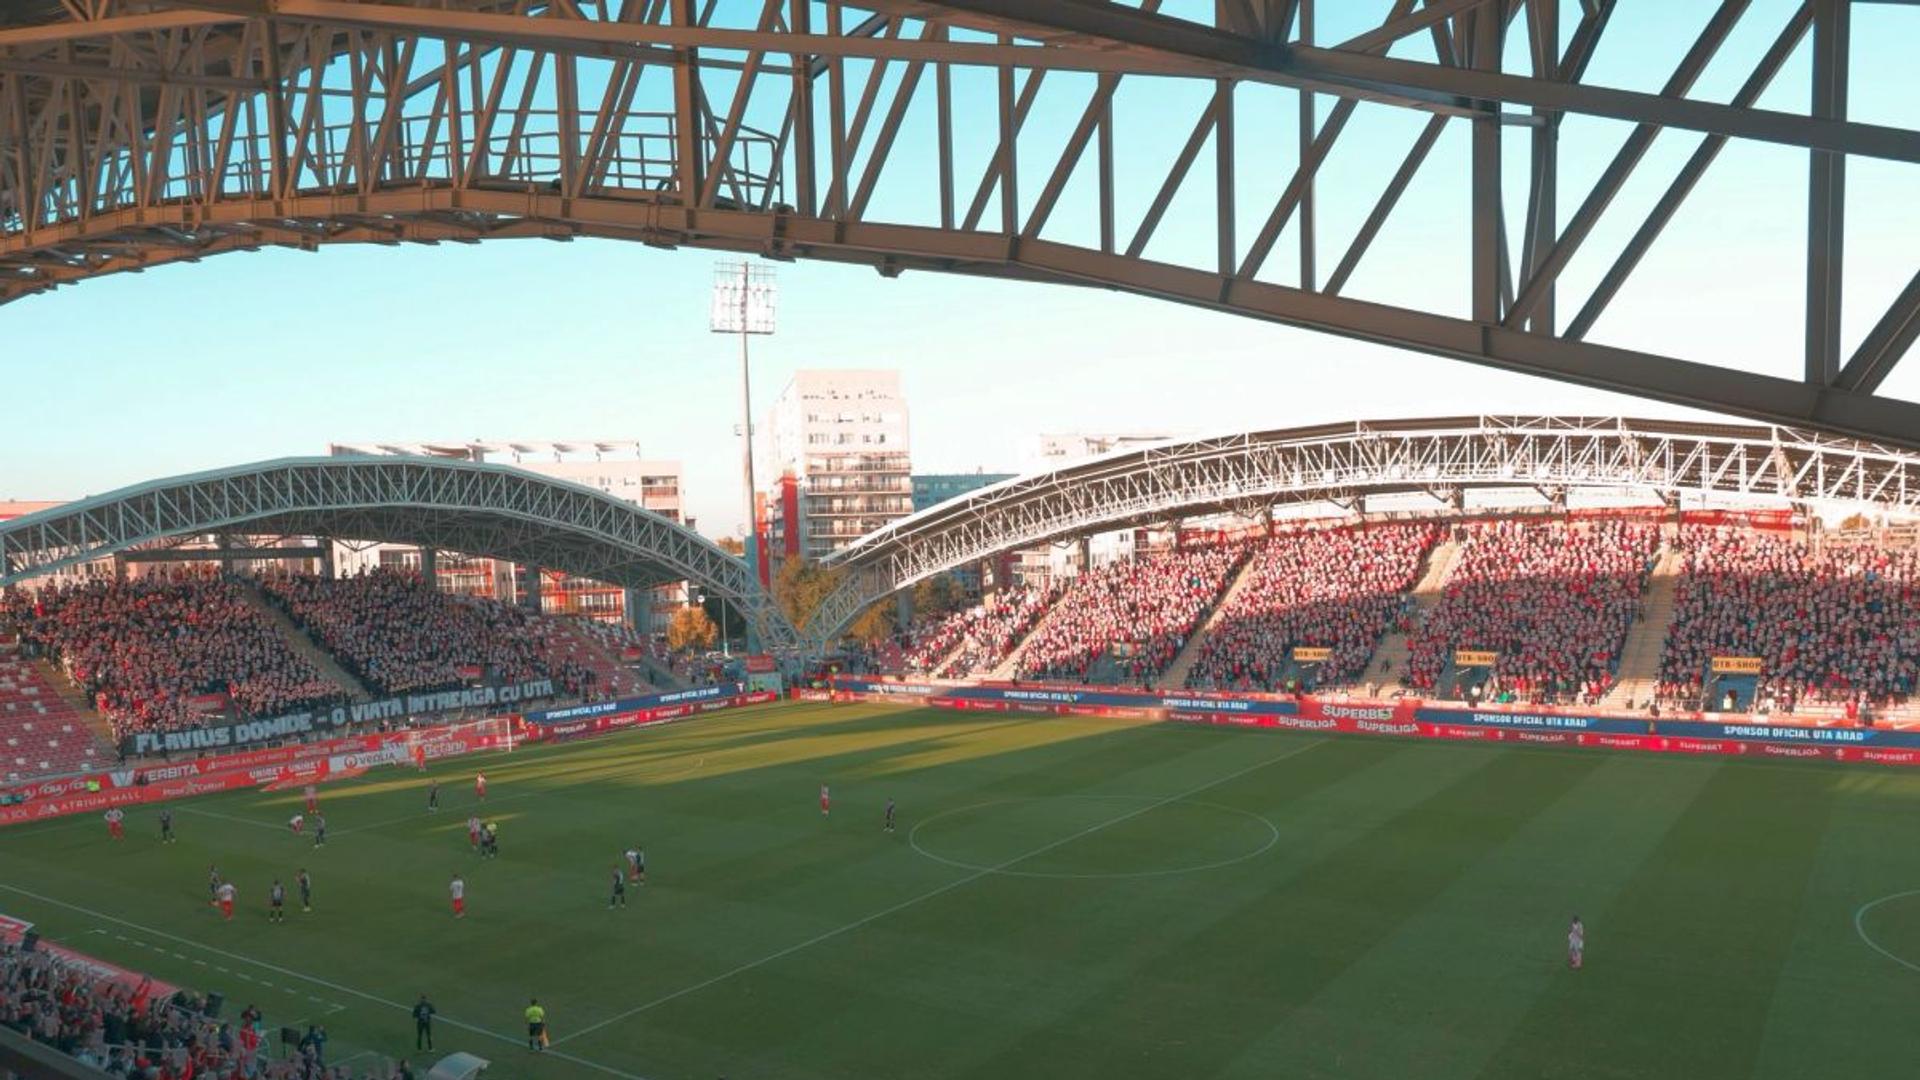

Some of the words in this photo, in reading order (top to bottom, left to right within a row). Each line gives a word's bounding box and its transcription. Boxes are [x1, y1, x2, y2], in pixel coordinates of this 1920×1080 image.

[135, 726, 230, 753] FLAVIUS
[236, 713, 312, 743] DOMIDE
[331, 708, 345, 725] O
[351, 700, 403, 722] VIATA
[407, 688, 496, 714] INTREAGA
[500, 684, 520, 702] CU
[523, 679, 553, 698] UTA
[1321, 703, 1395, 719] SUPERBET
[1279, 716, 1337, 728] SUPERLIGA
[1356, 720, 1419, 732] SUPERLIGA
[1473, 713, 1511, 724] SPONSOR
[1513, 715, 1544, 725] OFICIAL
[1546, 717, 1562, 726] UTA
[1564, 718, 1588, 728] ARAD
[1723, 725, 1769, 736] SPONSOR
[1773, 727, 1810, 738] OFICIAL
[1813, 729, 1833, 739] UTA
[1835, 730, 1864, 741] ARAD
[1763, 746, 1822, 757] SUPERLIGA
[1863, 751, 1915, 761] SUPERBET
[61, 797, 107, 812] ATRIUM
[111, 790, 142, 803] MALL
